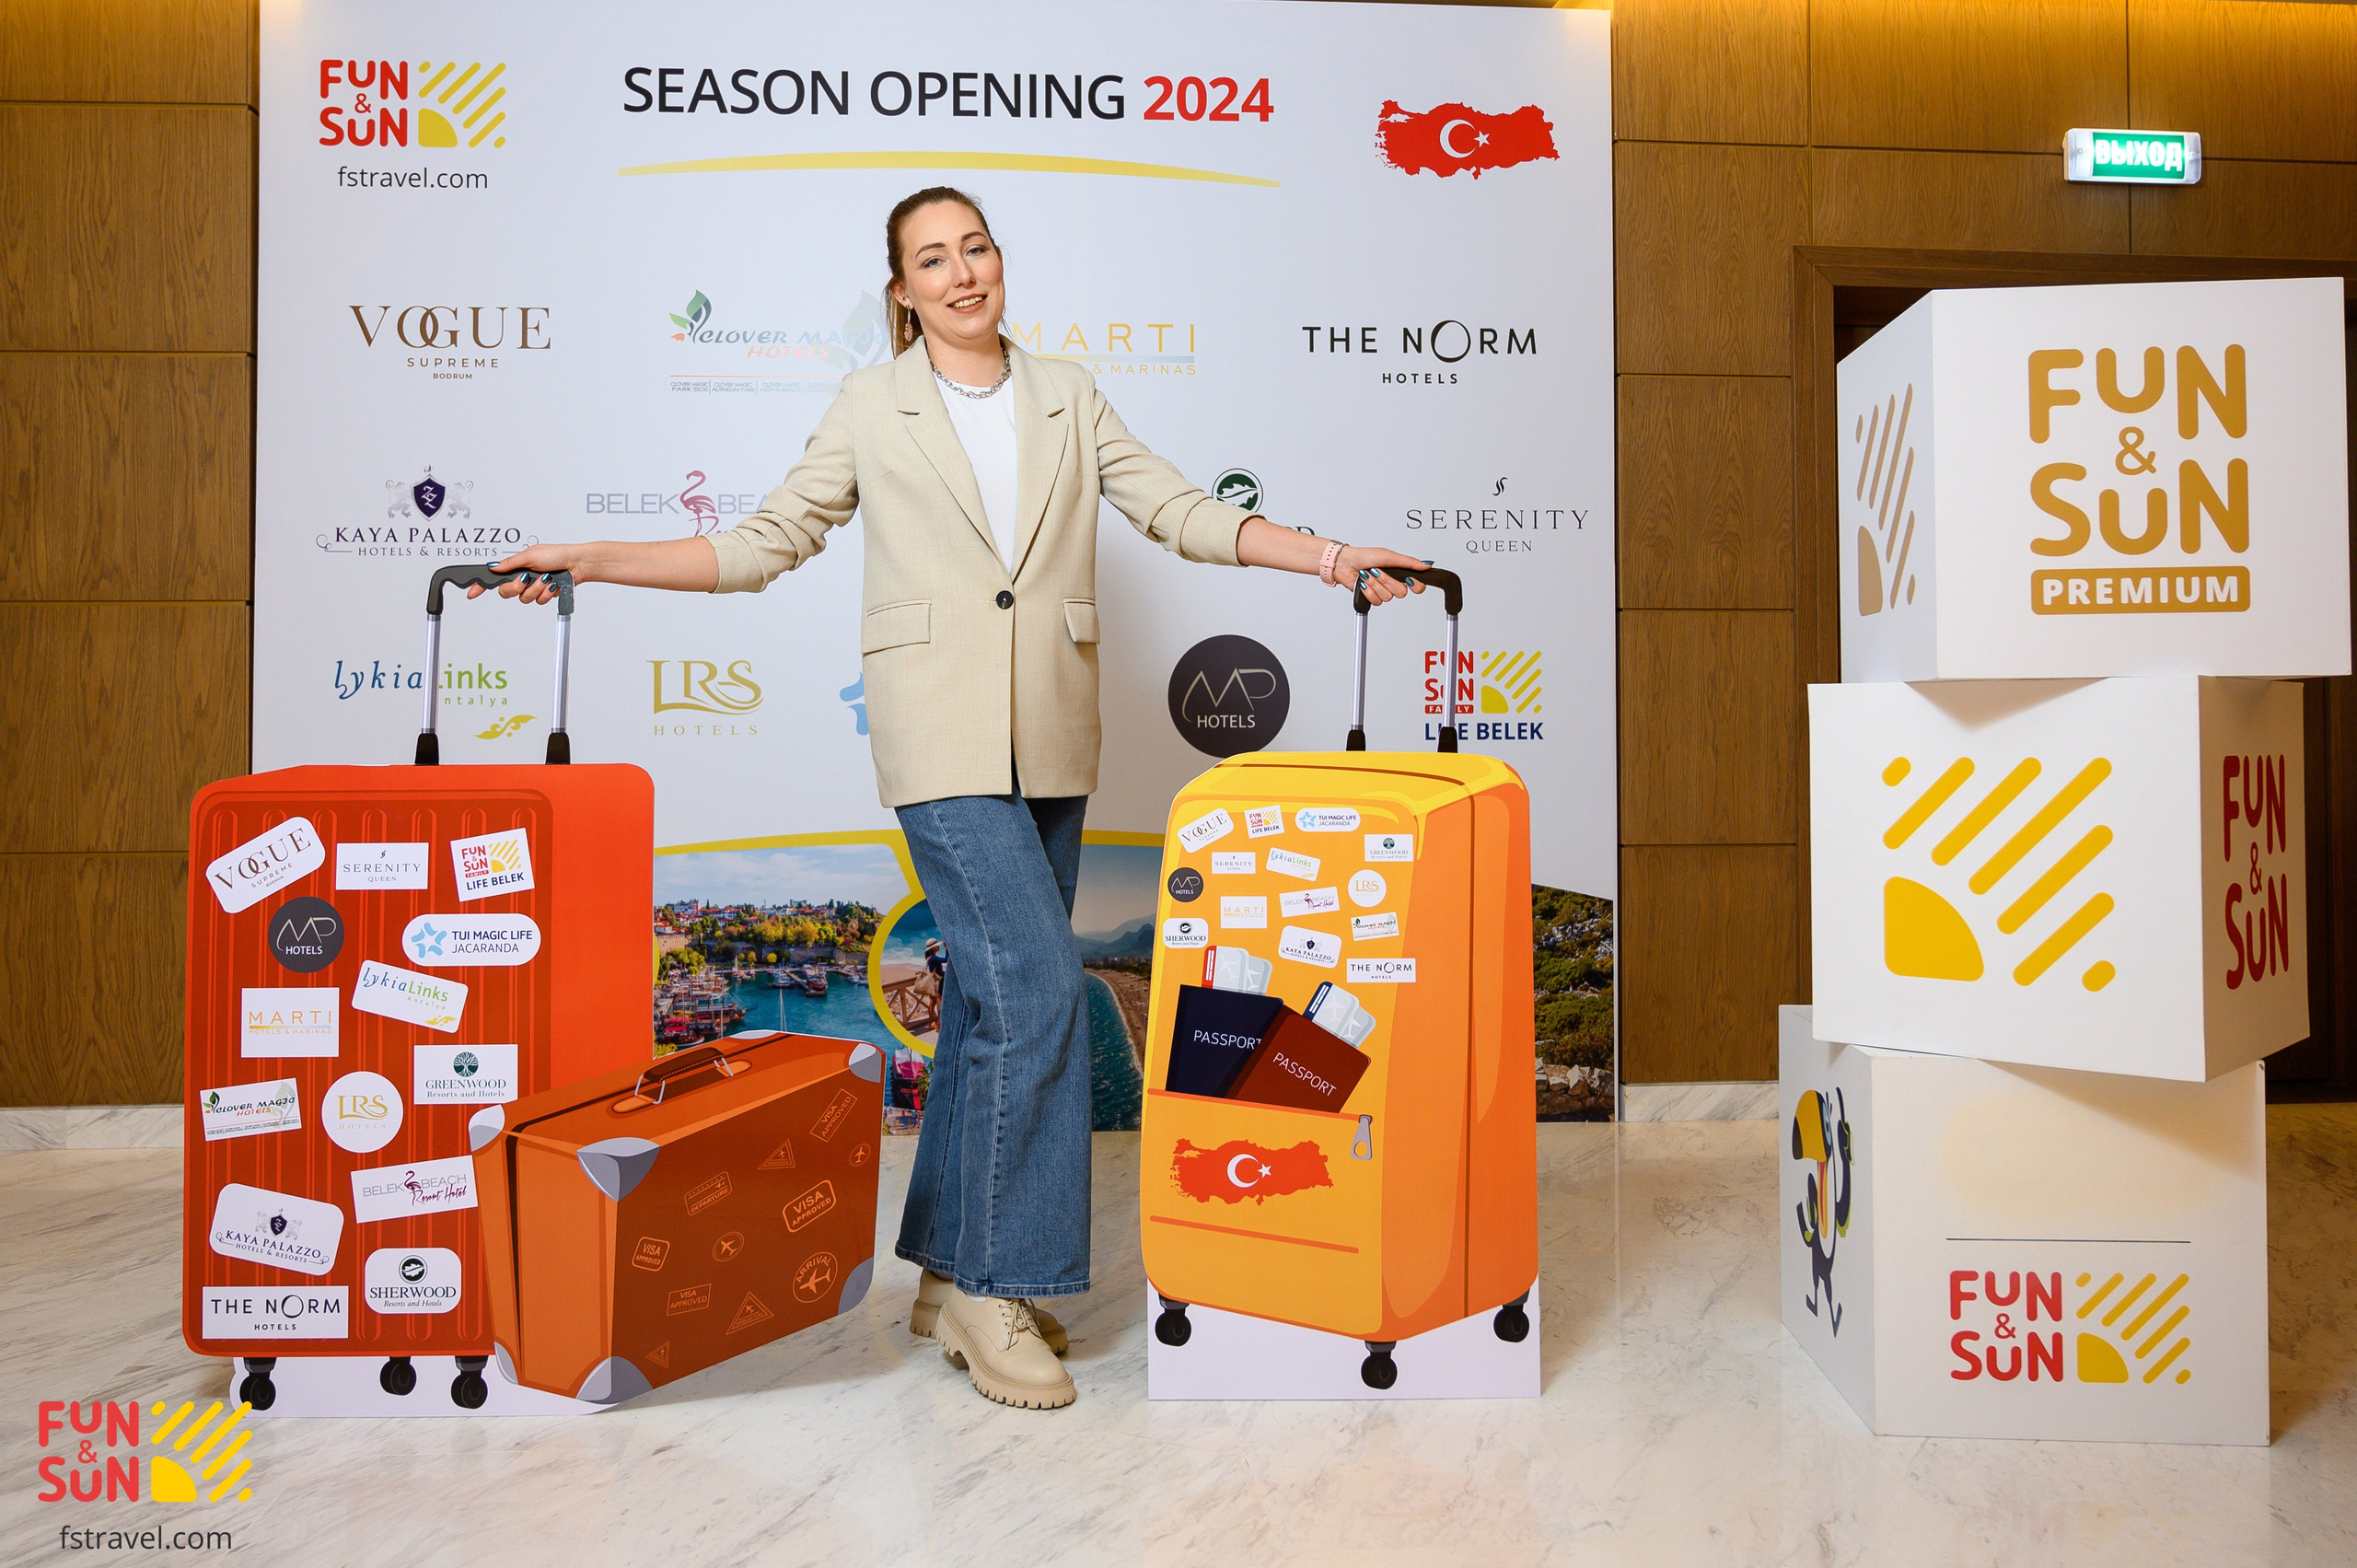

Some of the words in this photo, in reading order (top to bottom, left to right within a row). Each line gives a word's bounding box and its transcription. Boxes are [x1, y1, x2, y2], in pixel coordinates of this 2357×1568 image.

[319, 59, 409, 99] FUN
[354, 92, 372, 113] &
[623, 67, 850, 115] SEASON
[870, 71, 1125, 120] OPENING
[1143, 75, 1274, 122] 2024
[319, 107, 409, 147] SUN
[2096, 140, 2182, 171] ВЫХОД
[337, 167, 489, 189] fstravel.com
[348, 305, 552, 350] VOGUE
[699, 330, 787, 343] CLOVER
[796, 330, 888, 345] MAGIC
[1012, 321, 1195, 353] MARTI
[1302, 325, 1378, 354] THE
[1402, 319, 1537, 363] NORM
[747, 345, 830, 359] HOTELS
[407, 357, 499, 368] SUPREME
[1093, 364, 1103, 374] &
[1110, 364, 1196, 376] MARINAS
[1382, 372, 1458, 384] HOTELS
[2028, 343, 2247, 444] FUN
[2115, 426, 2156, 475] &
[586, 493, 680, 514] BELEK
[2030, 458, 2249, 557] SUN
[1406, 509, 1589, 529] SERENITY
[335, 527, 394, 542] KAYA
[409, 528, 521, 543] PALAZZO
[358, 547, 412, 556] HOTELS
[420, 547, 430, 556] &
[437, 547, 498, 556] RESORTS
[1466, 540, 1532, 553] QUEEN
[2042, 575, 2238, 605] PREMIUM
[646, 660, 764, 715] LRS
[1182, 668, 1276, 723] MP
[1424, 678, 1473, 701] SN
[445, 695, 507, 707] ntalya
[654, 725, 758, 736] HOTELS
[1197, 714, 1255, 728] HOTELS
[1477, 723, 1544, 740] BELEK
[2223, 754, 2286, 862] FUN
[1181, 813, 1227, 842] VOGUE
[215, 828, 311, 889] VOGUE
[461, 844, 486, 859] FUN
[343, 863, 421, 873] SERENITY
[463, 857, 488, 872] SUN
[2249, 842, 2262, 895] &
[251, 863, 293, 889] SUPREME
[466, 878, 489, 890] LIFE
[491, 872, 525, 886] BELEK
[1171, 876, 1200, 892] MP
[1355, 880, 1379, 892] LRS
[276, 916, 337, 951] MP
[451, 931, 470, 940] TUI
[473, 930, 507, 940] MAGIC
[511, 930, 532, 940] LIFE
[2225, 873, 2289, 990] SUN
[285, 946, 323, 955] HOTELS
[452, 943, 519, 954] JACARANDA
[1285, 947, 1302, 955] KAYA
[1303, 950, 1332, 961] PALAZZO
[1376, 962, 1412, 974] NORM
[407, 996, 446, 1010] Antalya
[249, 1010, 331, 1024] MARTI
[425, 1079, 506, 1089] GREENWOOD
[1272, 1052, 1337, 1097] PASSPORT
[216, 1102, 252, 1113] CLOVER
[257, 1097, 296, 1108] MAGIC
[237, 1107, 272, 1117] HOTELS
[336, 1095, 389, 1120] LRS
[820, 1105, 838, 1123] VISA
[821, 1096, 852, 1137] APPROVED
[363, 1182, 405, 1197] BELEK
[421, 1174, 467, 1189] BEACH
[445, 1184, 467, 1203] Hotel
[691, 1188, 729, 1214] DEPARTURE
[793, 1191, 824, 1214] VISA
[792, 1197, 831, 1227] APPROVED
[226, 1230, 258, 1246] KAYA
[262, 1238, 321, 1259] PALAZZO
[236, 1243, 263, 1254] HOTELS
[275, 1251, 308, 1263] RESORTS
[643, 1243, 661, 1257] VISA
[635, 1254, 661, 1265] APPROVED
[796, 1255, 831, 1283] ARRIVAL
[369, 1286, 457, 1298] SHERWOOD
[669, 1295, 708, 1309] APPROVED
[679, 1290, 697, 1298] VISA
[1949, 1270, 2062, 1322] FUN
[211, 1299, 252, 1314] THE
[265, 1295, 341, 1318] NORM
[1994, 1313, 2015, 1339] &
[1950, 1330, 2063, 1382] SUN
